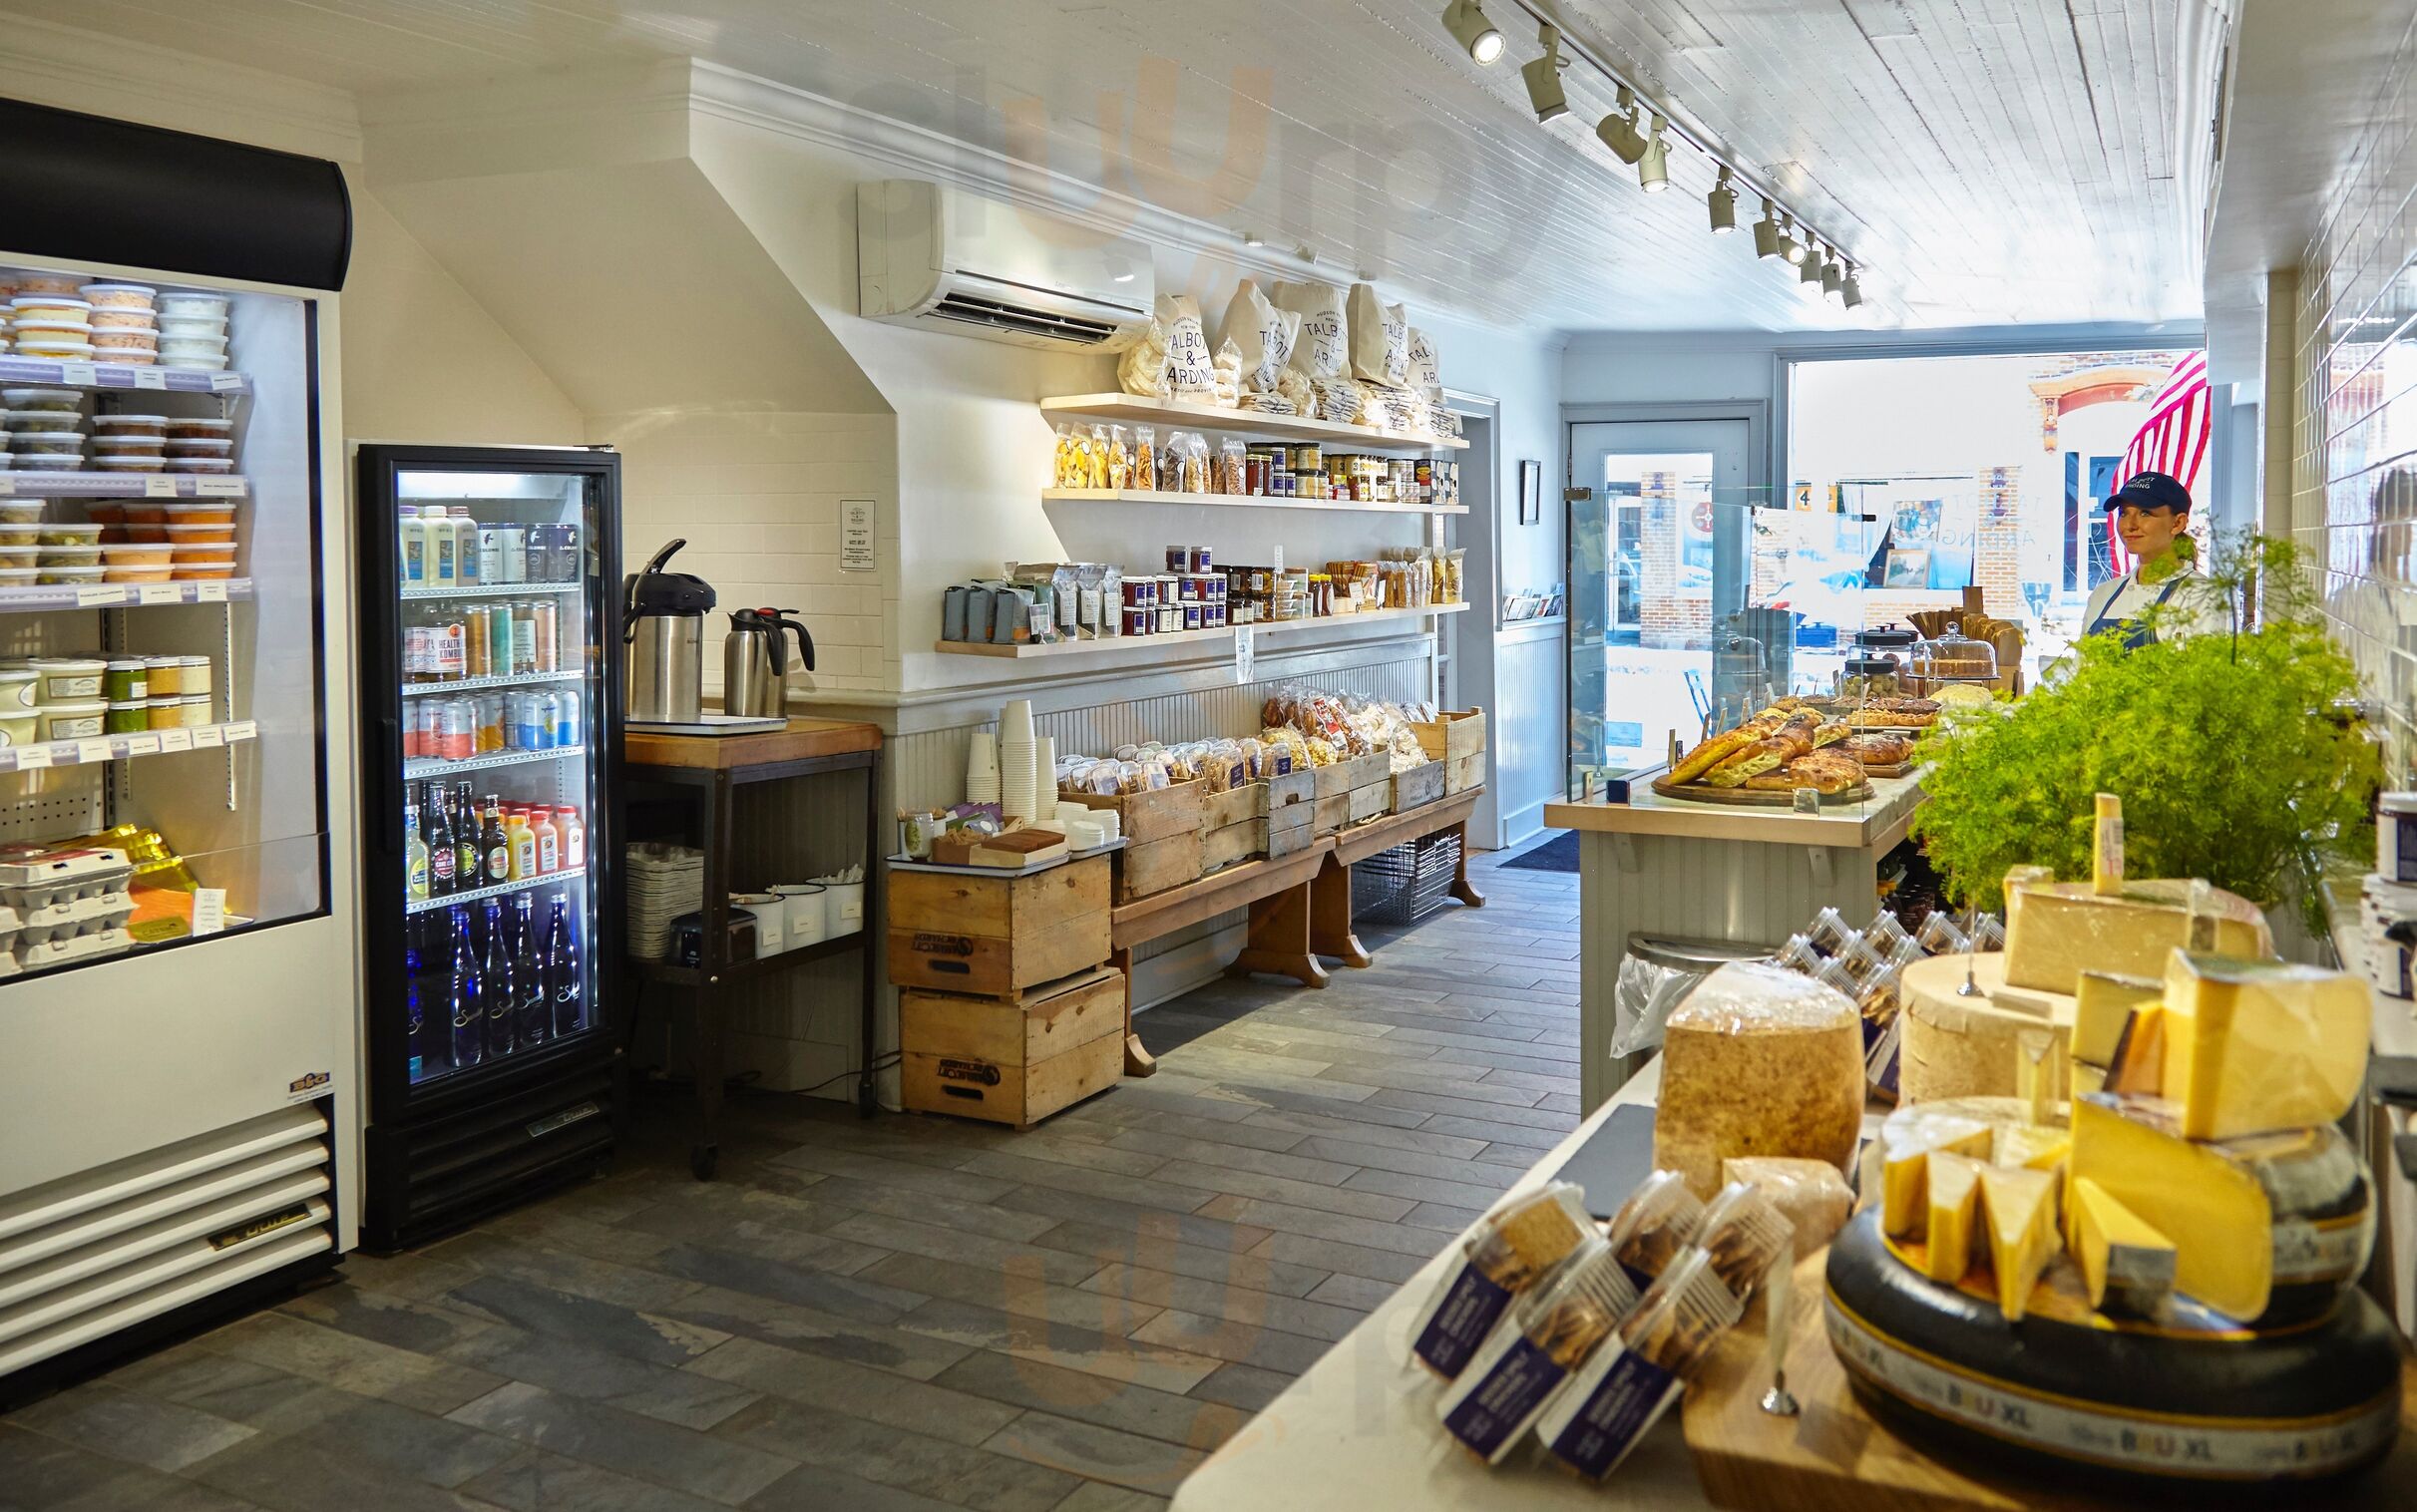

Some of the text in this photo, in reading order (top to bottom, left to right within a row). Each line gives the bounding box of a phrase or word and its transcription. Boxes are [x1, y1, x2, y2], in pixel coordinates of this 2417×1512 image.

[1185, 350, 1196, 366] &
[1166, 366, 1214, 385] ARDING
[1800, 490, 1811, 507] 4
